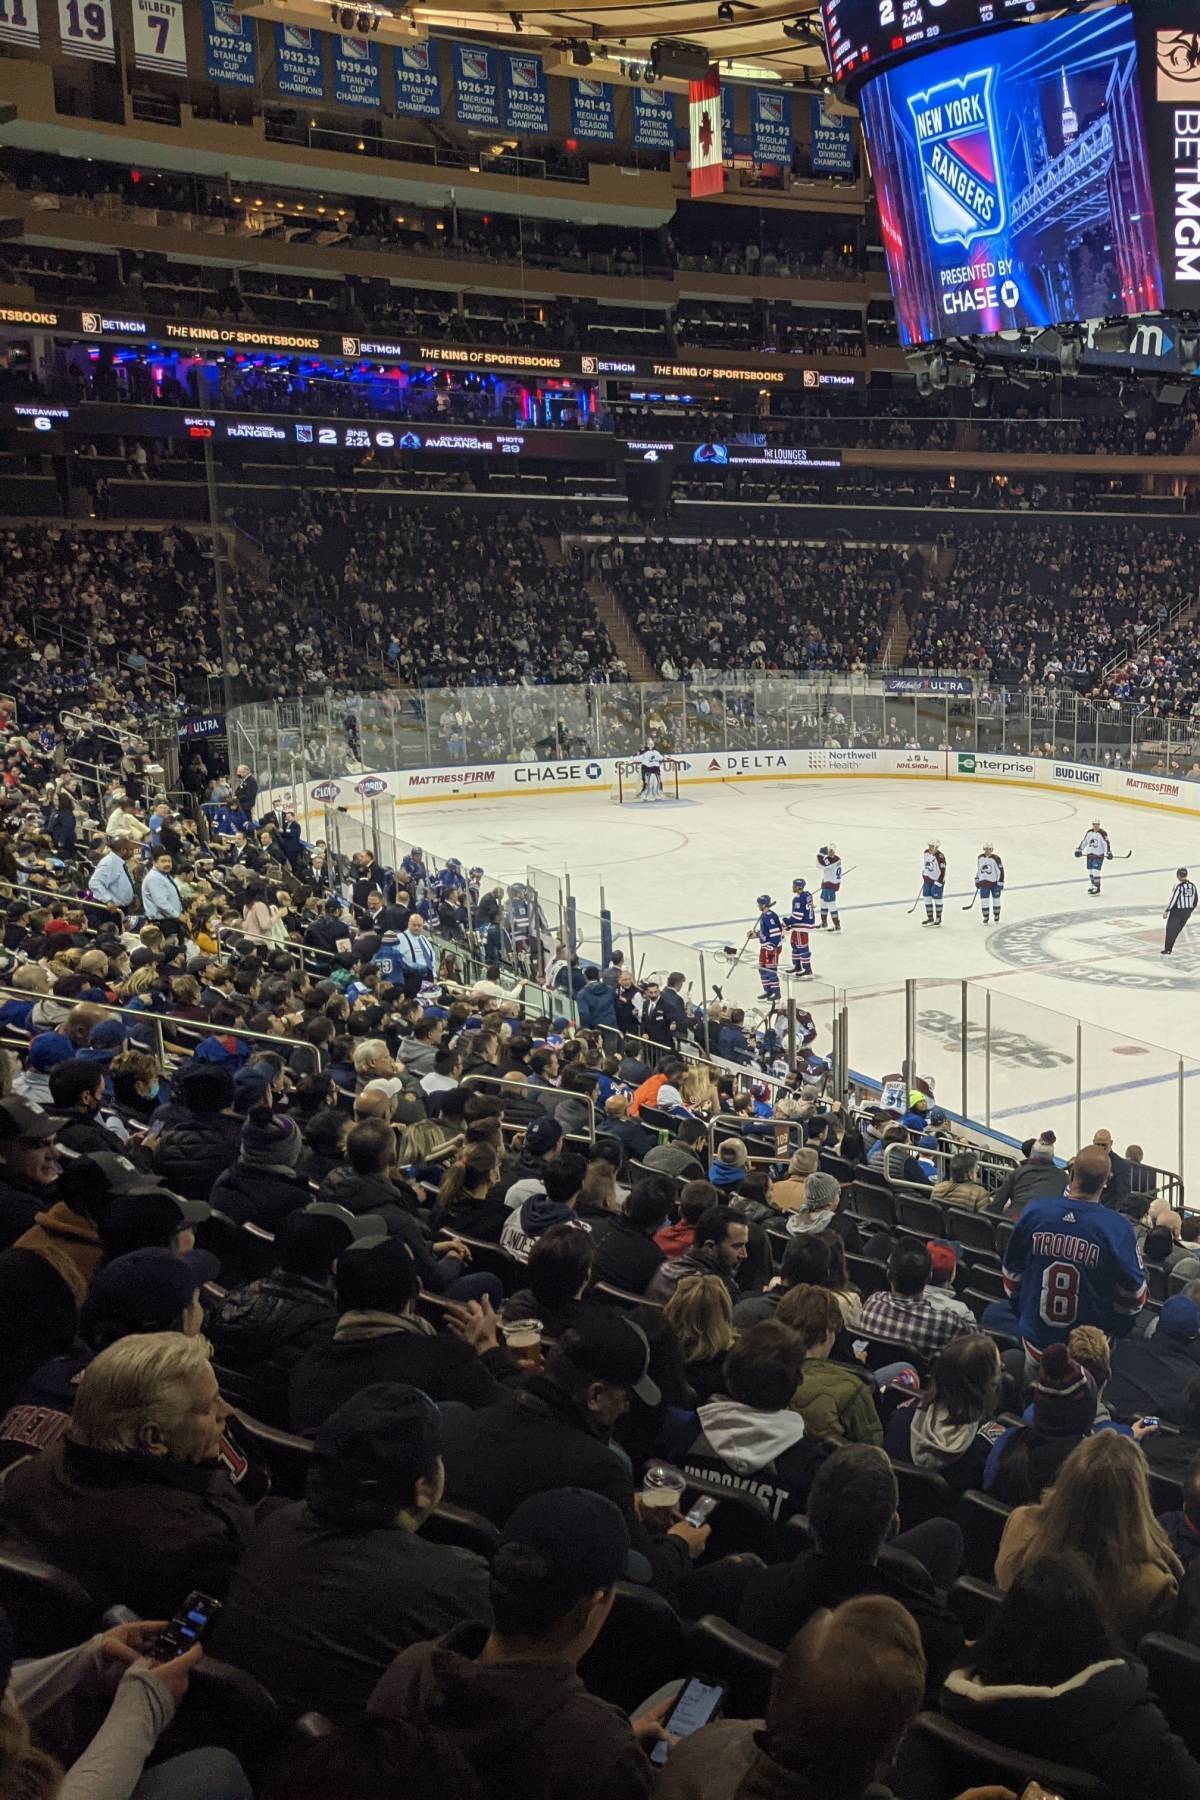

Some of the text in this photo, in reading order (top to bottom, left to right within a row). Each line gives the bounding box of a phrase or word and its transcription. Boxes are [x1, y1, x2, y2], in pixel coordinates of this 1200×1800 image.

[138, 2, 176, 17] GILBERT
[66, 0, 106, 41] 19
[902, 8, 923, 29] 2:24
[147, 15, 169, 54] 7
[209, 35, 252, 53] 1927-28
[213, 49, 248, 64] STANLEY
[279, 48, 320, 66] 1932-33
[223, 61, 239, 70] CUP
[283, 63, 316, 76] STANLEY
[336, 60, 378, 76] 1939-40
[209, 69, 255, 83] CHAMPIONS
[293, 74, 309, 83] CUP
[340, 74, 374, 87] STANLEY
[397, 70, 438, 86] 1993-94
[279, 81, 323, 96] CHAMPIONS
[350, 85, 366, 94] CUP
[401, 84, 434, 96] STANLEY
[457, 80, 496, 96] 1926-27
[336, 91, 380, 106] CHAMPIONS
[411, 94, 426, 103] CUP
[459, 93, 495, 106] AMERICAN
[507, 88, 546, 104] 1931-32
[397, 101, 440, 115] CHAMPIONS
[462, 103, 493, 114] DIVISION
[508, 102, 545, 114] AMERICAN
[574, 97, 611, 113] 1941-42
[457, 111, 499, 124] CHAMPIONS
[512, 111, 542, 122] DIVISION
[576, 110, 609, 122] REGULAR
[635, 106, 673, 121] 1989-90
[917, 94, 985, 139] NEW YORK
[506, 118, 548, 132] CHAMPIONS
[579, 119, 608, 131] SEASON
[639, 118, 668, 130] PATRICK
[754, 121, 790, 136] 1991-92
[573, 127, 614, 140] CHAMPIONS
[640, 128, 669, 138] DIVISION
[756, 134, 788, 145] REGULAR
[814, 129, 850, 143] 1993-94
[634, 135, 675, 148] CHAMPIONS
[759, 143, 785, 154] SEASON
[816, 142, 848, 152] ATLANTIC
[753, 151, 791, 162] CHAMPIONS
[818, 150, 847, 160] DIVISION
[813, 158, 853, 169] CHAMPIONS
[931, 145, 995, 222] RANGERS
[1174, 110, 1200, 281] BETMGM
[941, 259, 1013, 286] PRESENTED BY
[943, 285, 1000, 315] CHASE
[102, 319, 146, 333] BETMGM
[166, 325, 319, 348] THE KING OF SPORTSBOOKS
[360, 343, 401, 355] BETMGM
[420, 348, 561, 368] THE KING OF SPORTSBOOKS
[598, 362, 636, 372] BETMGM
[653, 365, 784, 382] THE KING OF SPORTSBOOKS
[819, 375, 854, 384] BETMGM
[15, 407, 69, 417] TAKEAWAYS
[34, 417, 52, 430] 6
[228, 428, 286, 439] RANGERS
[319, 429, 337, 444] 2
[376, 432, 395, 446] 6
[345, 437, 371, 447] 2:24
[425, 439, 493, 450] AVALANCHE
[502, 444, 520, 453] 29
[643, 450, 658, 461] 4
[764, 449, 807, 460] THE LOUNGES
[931, 682, 964, 690] ULTRA
[193, 719, 219, 734] ULTRA
[727, 755, 787, 769] DELTA
[829, 751, 877, 760] Northwell
[964, 758, 1033, 773] enterprise
[514, 766, 581, 782] CHASE
[1055, 766, 1100, 784] BUD LIGHT
[1033, 1232, 1100, 1267] TROUBA
[1040, 1261, 1080, 1328] 8
